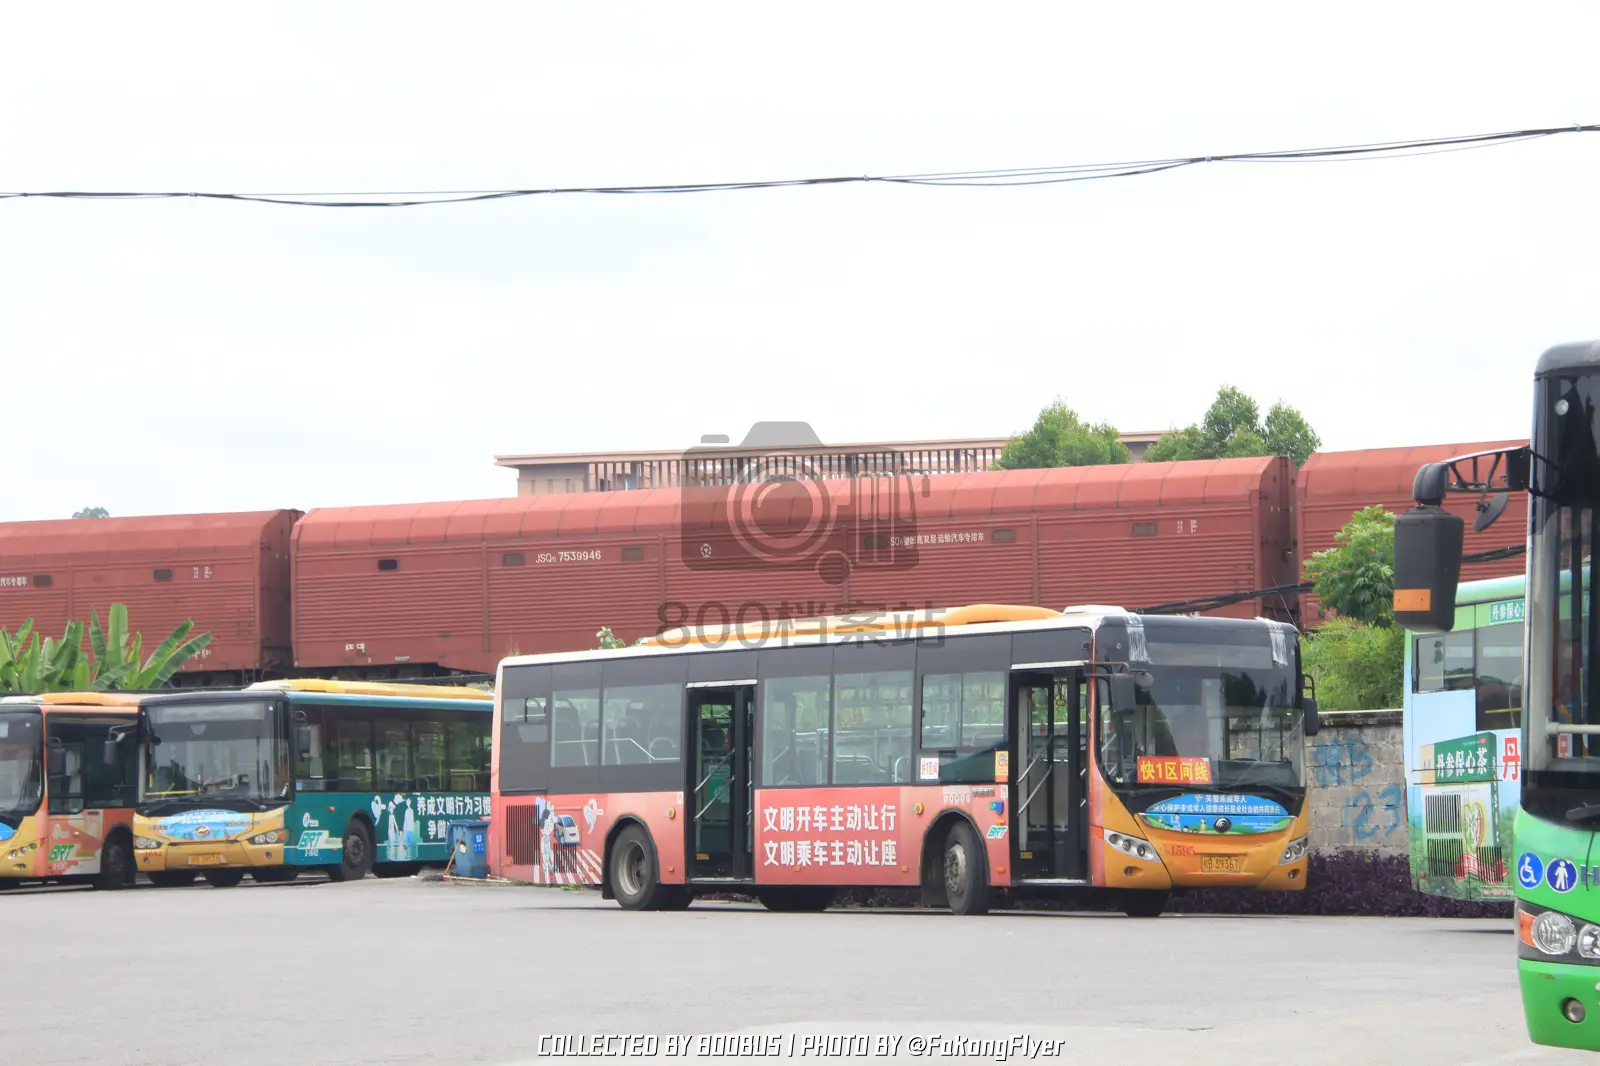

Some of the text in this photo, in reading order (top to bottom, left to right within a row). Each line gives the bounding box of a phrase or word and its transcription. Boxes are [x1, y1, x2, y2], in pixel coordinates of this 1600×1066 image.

[557, 549, 602, 562] 7539946
[1492, 601, 1525, 620] 丹参保心
[1140, 760, 1209, 782] 快1区间线
[1436, 747, 1488, 778] 丹参保心茶
[417, 796, 491, 816] 养成文明行为习惯
[763, 804, 897, 832] 文明开车主动让行
[298, 831, 323, 848] BRT
[48, 844, 75, 861] BRT
[763, 840, 898, 867] 文明乘车主动让座
